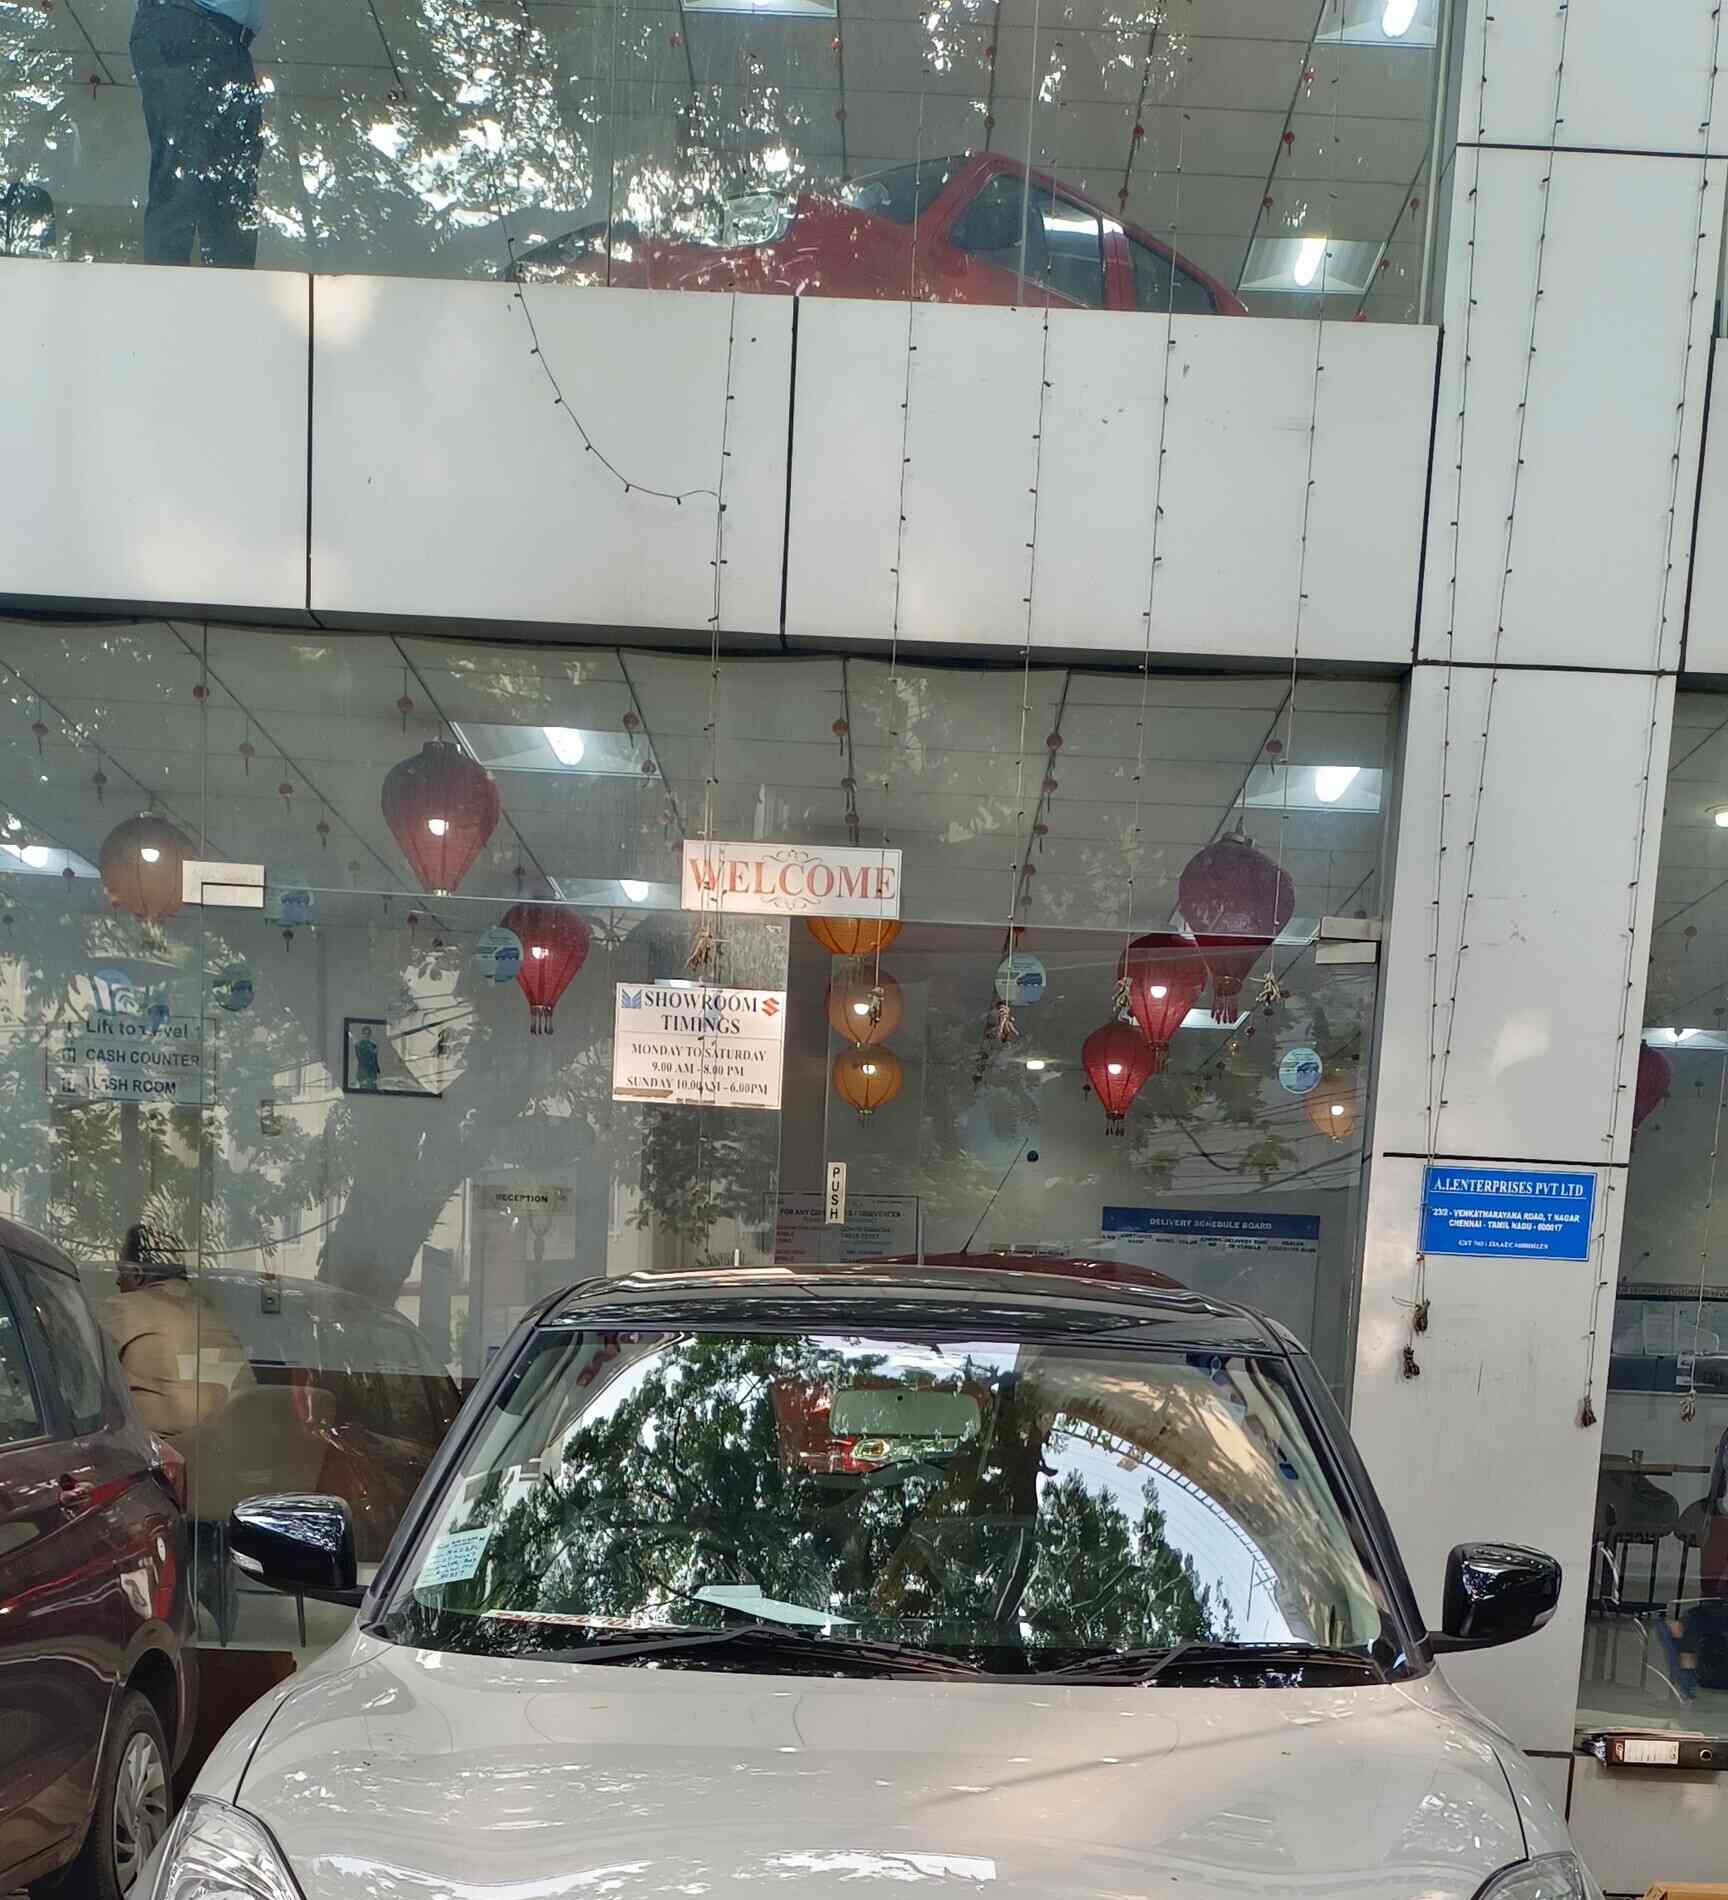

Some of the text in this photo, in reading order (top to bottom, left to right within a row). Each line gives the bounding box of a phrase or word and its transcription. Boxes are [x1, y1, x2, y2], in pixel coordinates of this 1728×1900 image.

[689, 858, 896, 899] WELCOME
[644, 991, 757, 1013] SHOWROOM
[661, 1014, 740, 1034] TIMINGS
[86, 1048, 200, 1066] CASH COUNTER
[632, 1043, 767, 1061] MONDAY TO SATURDAY
[652, 1062, 672, 1073] 9.00
[675, 1063, 694, 1074] AM
[727, 1066, 744, 1077] PM
[133, 1079, 176, 1094] ROOM
[626, 1077, 674, 1089] SUNDAY
[830, 1167, 841, 1219] PUSH
[1536, 1183, 1558, 1196] PVT
[1561, 1183, 1584, 1197] LTD
[1150, 1218, 1192, 1227] DELIVERY
